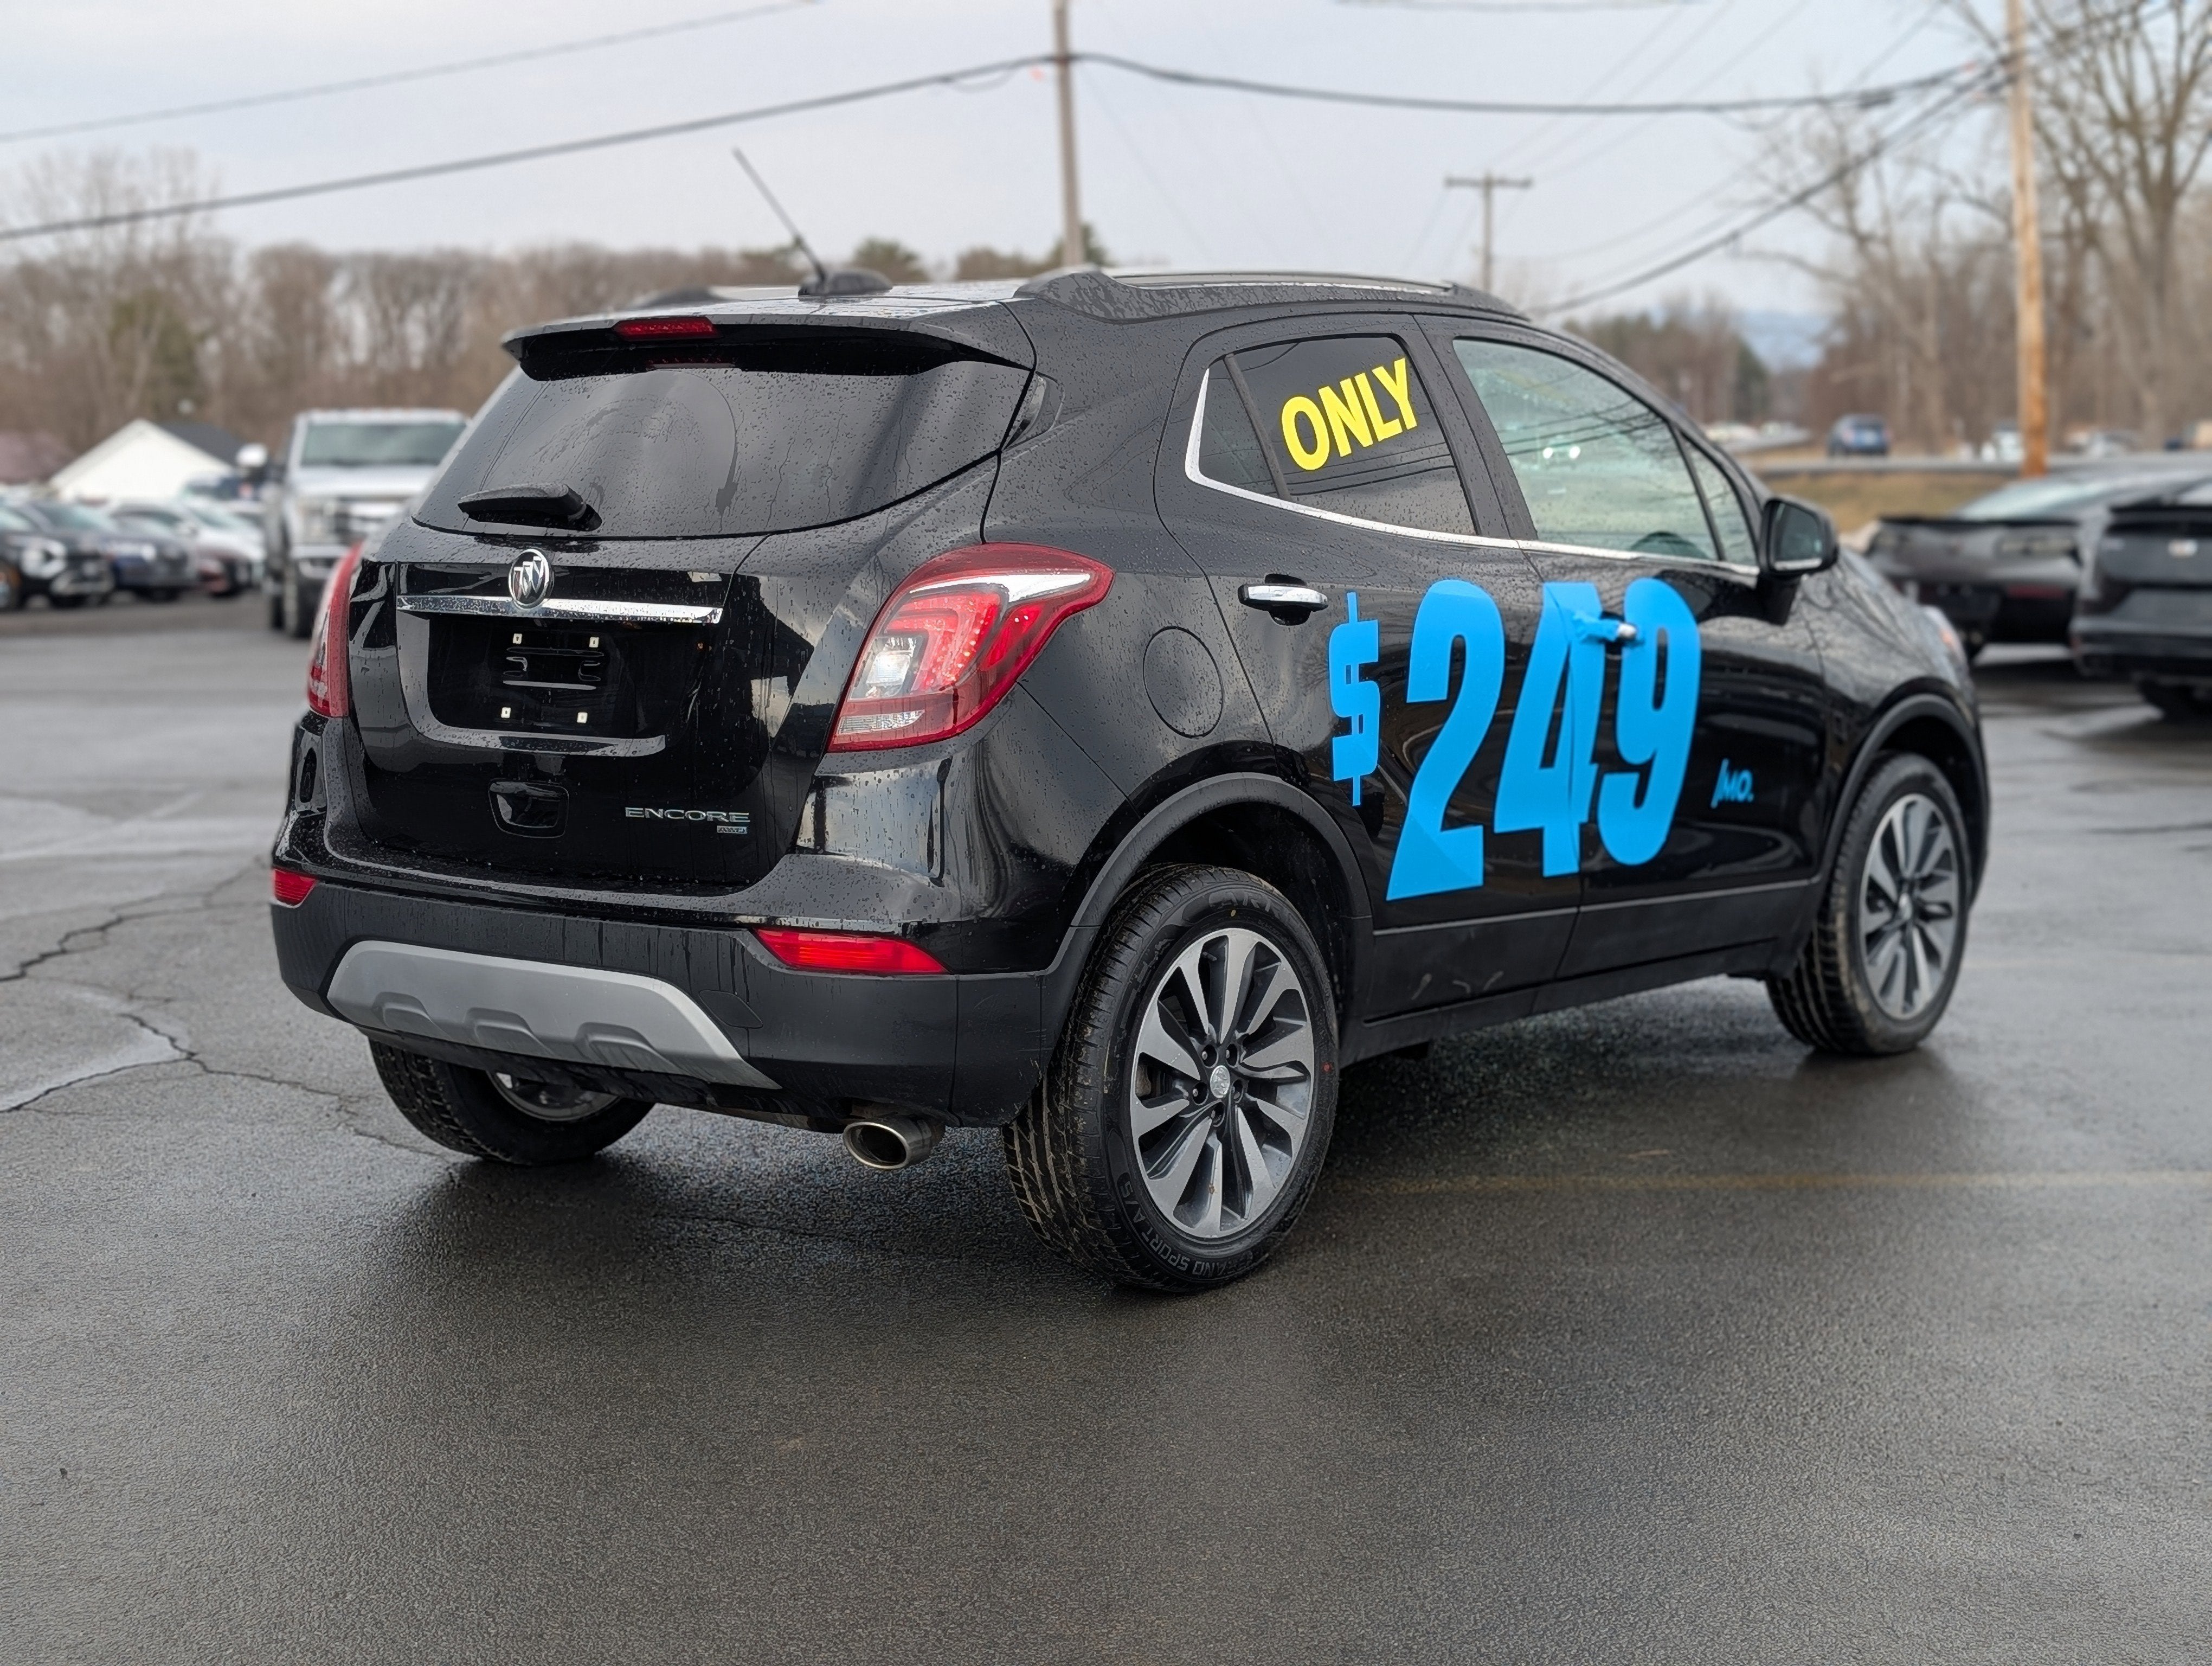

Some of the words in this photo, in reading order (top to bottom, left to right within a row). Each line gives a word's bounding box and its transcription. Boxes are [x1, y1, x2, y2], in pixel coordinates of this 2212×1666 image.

[1281, 358, 1418, 470] ONLY
[625, 806, 751, 823] ENCORE
[1141, 1226, 1191, 1271] SPORT
